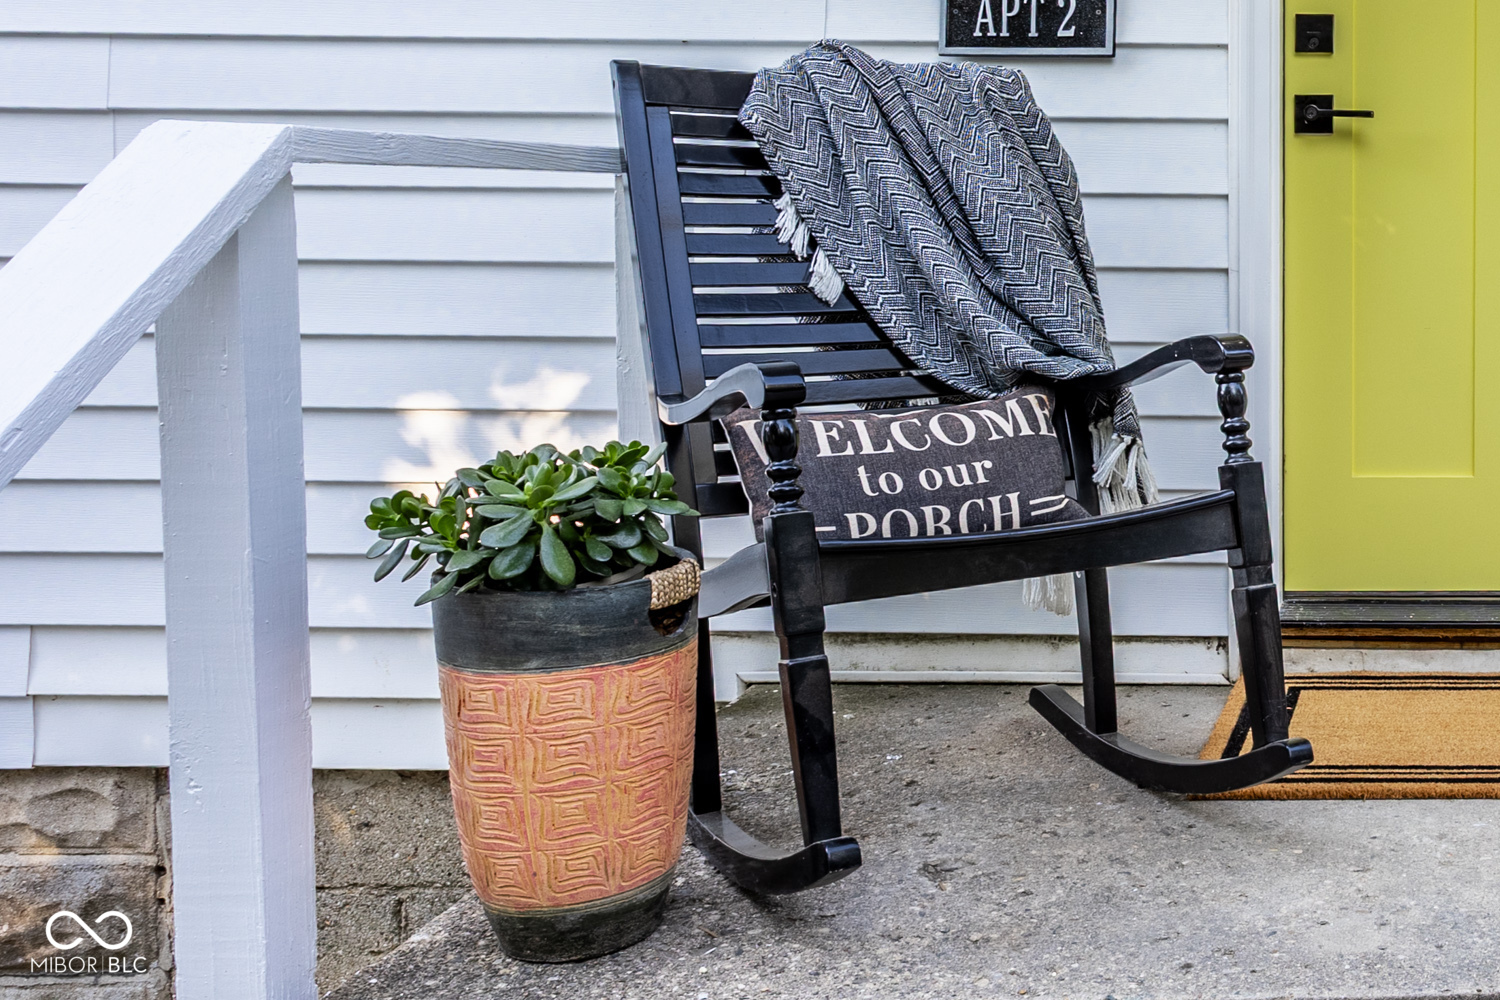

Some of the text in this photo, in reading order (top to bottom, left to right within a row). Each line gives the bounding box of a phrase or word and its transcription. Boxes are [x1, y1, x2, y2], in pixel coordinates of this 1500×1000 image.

[857, 459, 993, 497] to our
[844, 491, 1021, 539] PORCH
